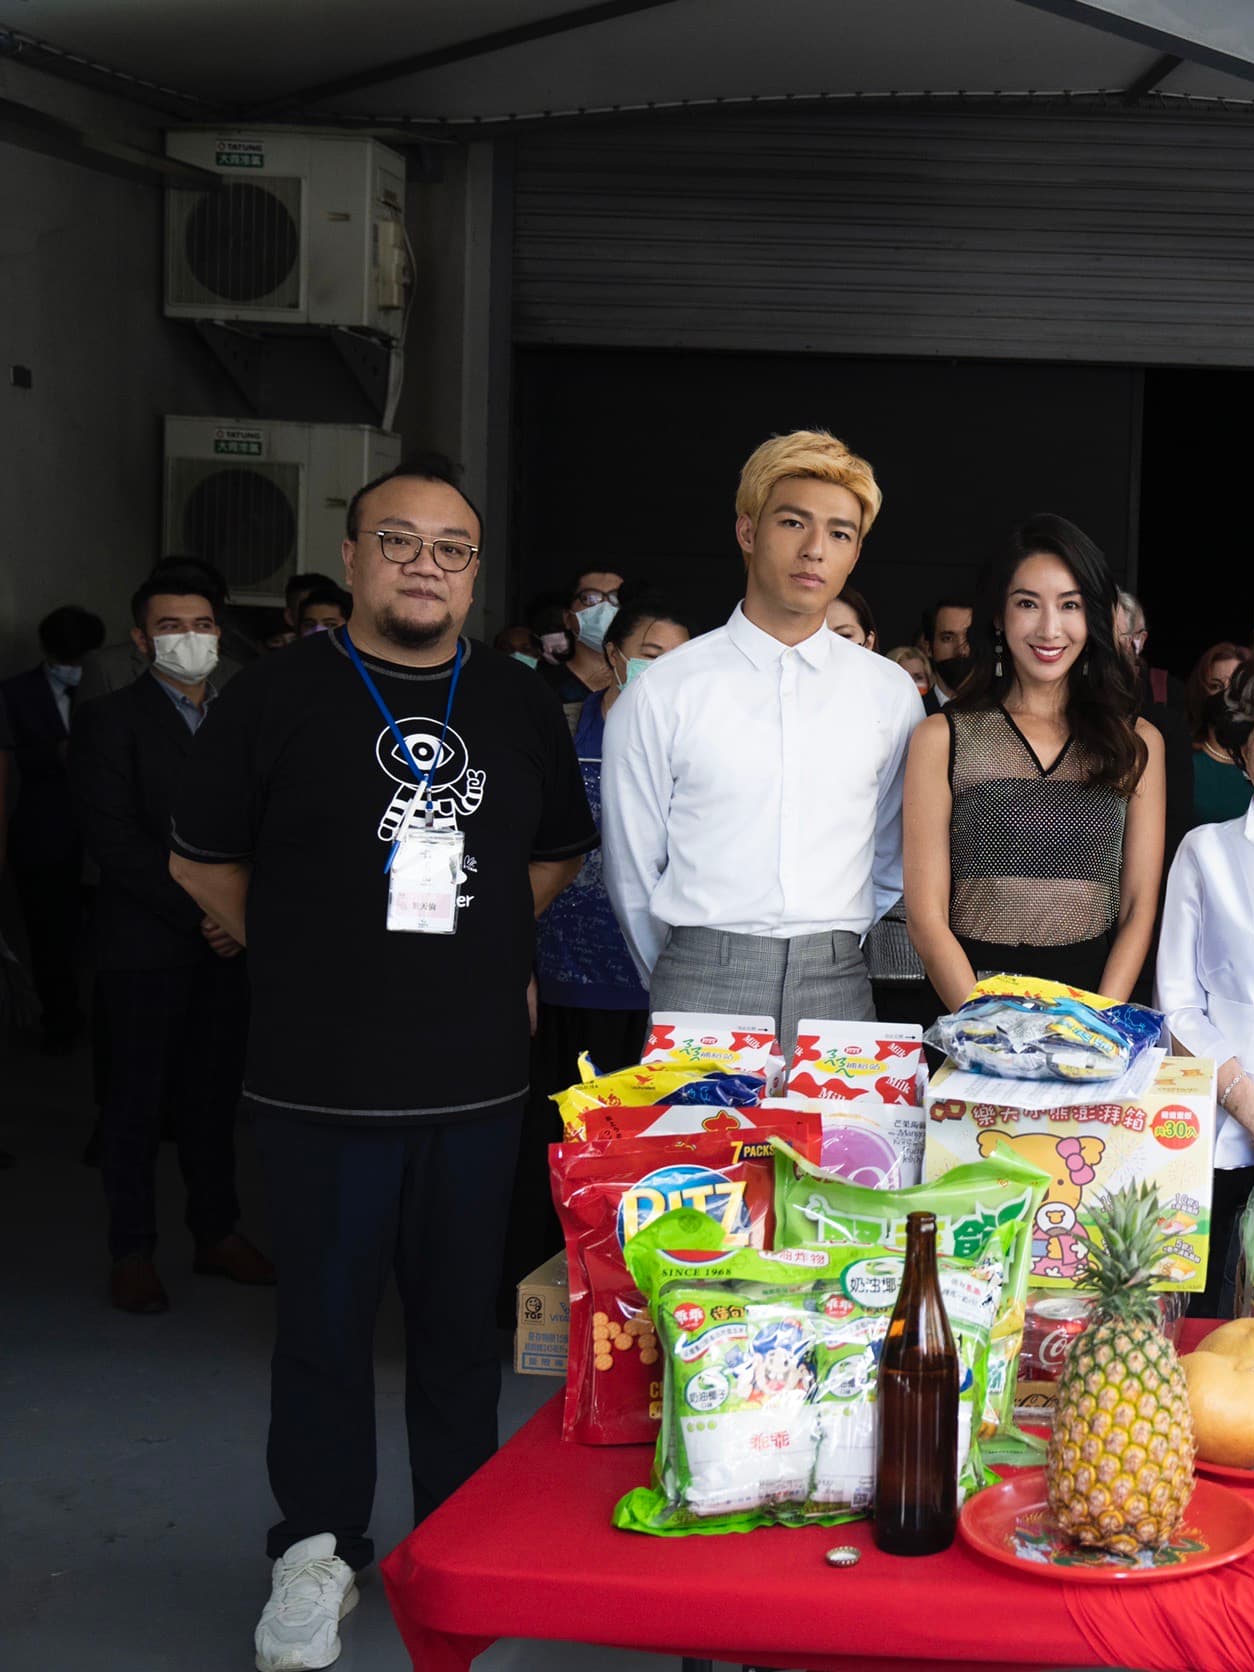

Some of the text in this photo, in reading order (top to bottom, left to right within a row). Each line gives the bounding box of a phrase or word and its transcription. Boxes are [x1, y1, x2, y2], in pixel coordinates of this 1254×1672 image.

[227, 143, 263, 152] TATUNG
[226, 431, 261, 439] TATUNG
[456, 894, 475, 908] er
[888, 1042, 908, 1058] Milk
[885, 1076, 912, 1095] Milk
[730, 1140, 776, 1165] 7 PACKS
[660, 1267, 732, 1281] SINCE 1968
[850, 1277, 903, 1293] 奶油椰
